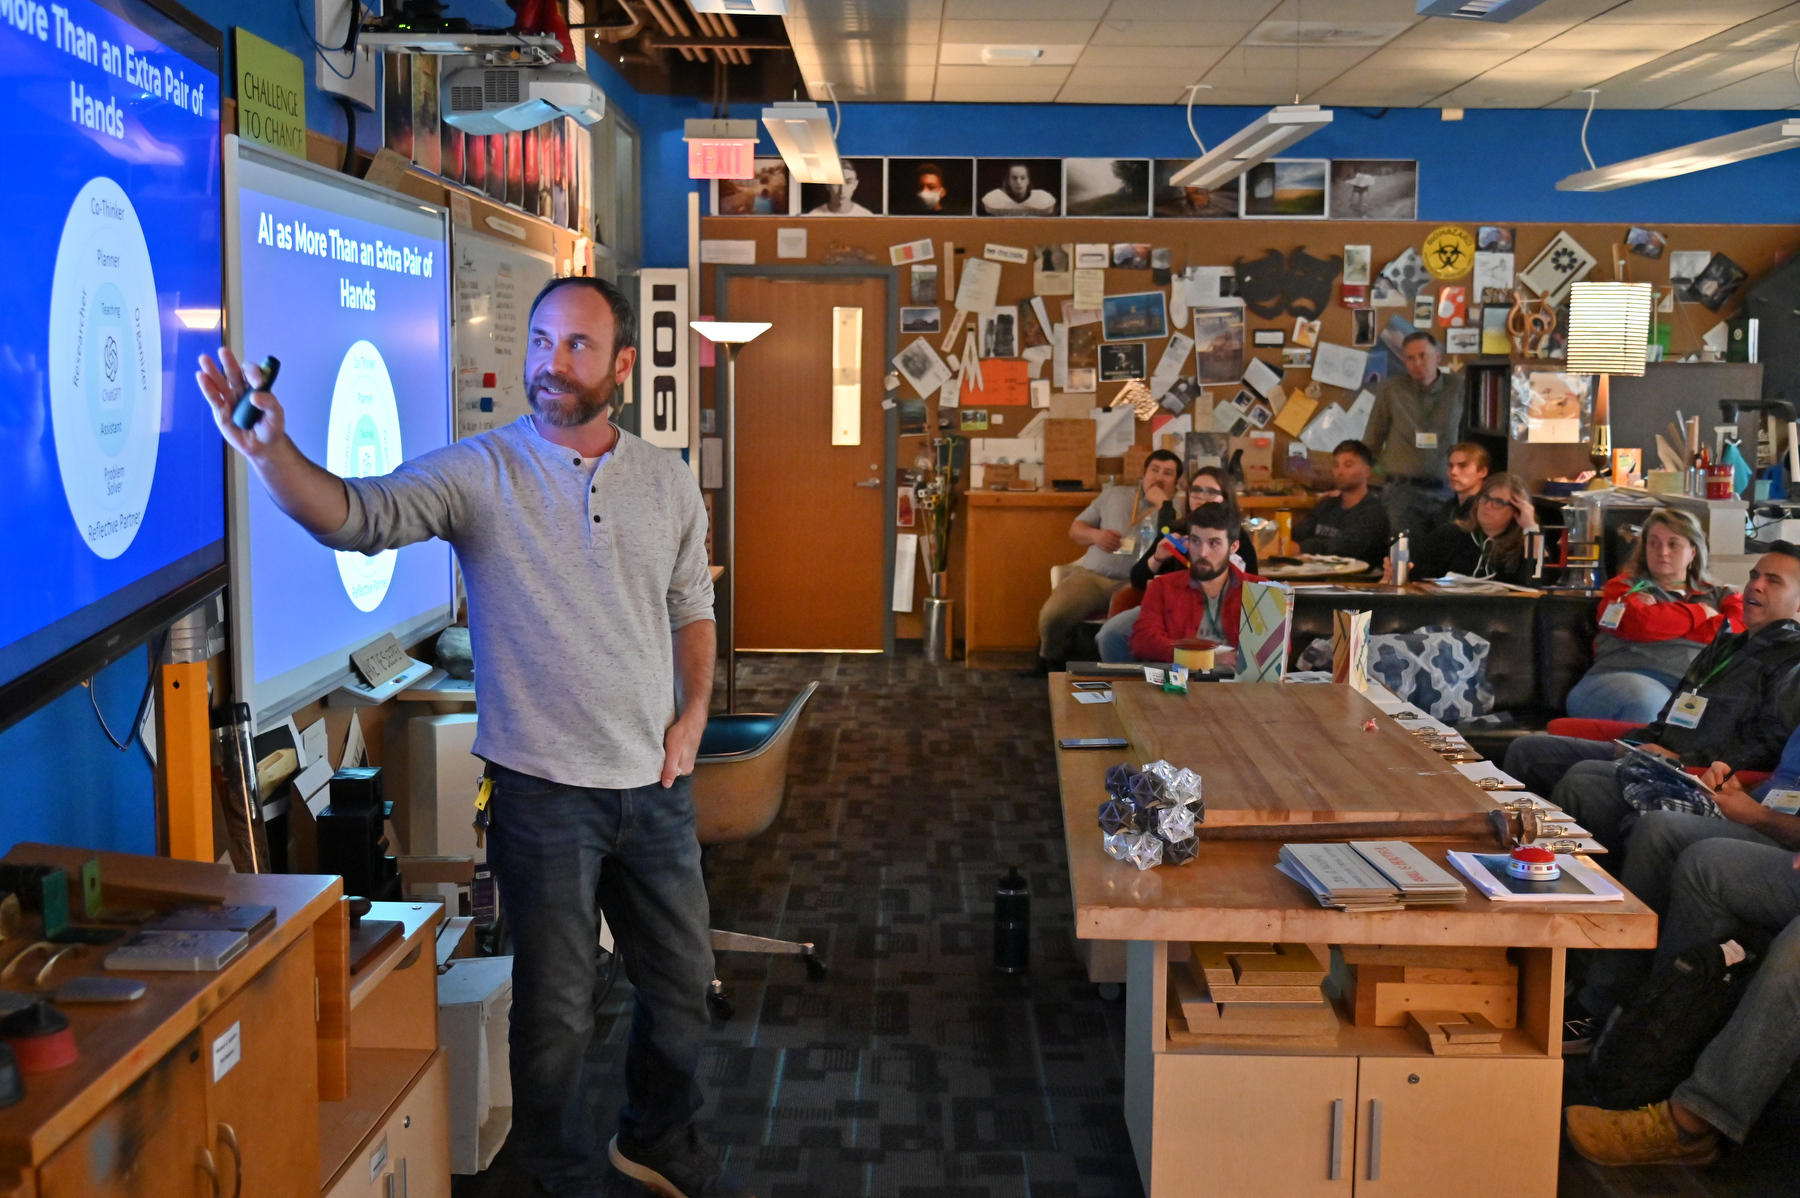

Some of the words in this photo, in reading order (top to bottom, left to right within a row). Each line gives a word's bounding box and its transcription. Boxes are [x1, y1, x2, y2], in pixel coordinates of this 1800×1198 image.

[51, 3, 98, 66] Than
[102, 40, 122, 78] an
[125, 44, 162, 97] Extra
[164, 66, 190, 110] Pair
[191, 83, 204, 117] of
[71, 80, 124, 139] Hands
[244, 72, 298, 117] CHALLENGE
[244, 109, 260, 139] TO
[702, 143, 743, 176] EXIT
[91, 197, 125, 221] Co-Thinker
[258, 212, 273, 246] AI
[277, 223, 292, 250] as
[295, 220, 327, 257] More
[329, 229, 358, 264] Than
[361, 243, 374, 267] an
[376, 240, 402, 272] Extra
[404, 247, 422, 276] Pair
[423, 252, 433, 277] of
[1426, 228, 1473, 246] BIOHAZARD
[97, 249, 120, 268] Planner
[340, 278, 376, 311] Hands
[101, 302, 121, 319] Teaching
[73, 288, 88, 387] Researcher
[134, 307, 147, 391] Organizer
[102, 387, 122, 402] ChatGPT
[101, 421, 122, 436] Assistant
[104, 466, 125, 482] Problem
[107, 481, 123, 496] Solver
[89, 518, 119, 541] Reflective
[120, 511, 141, 531] Partner
